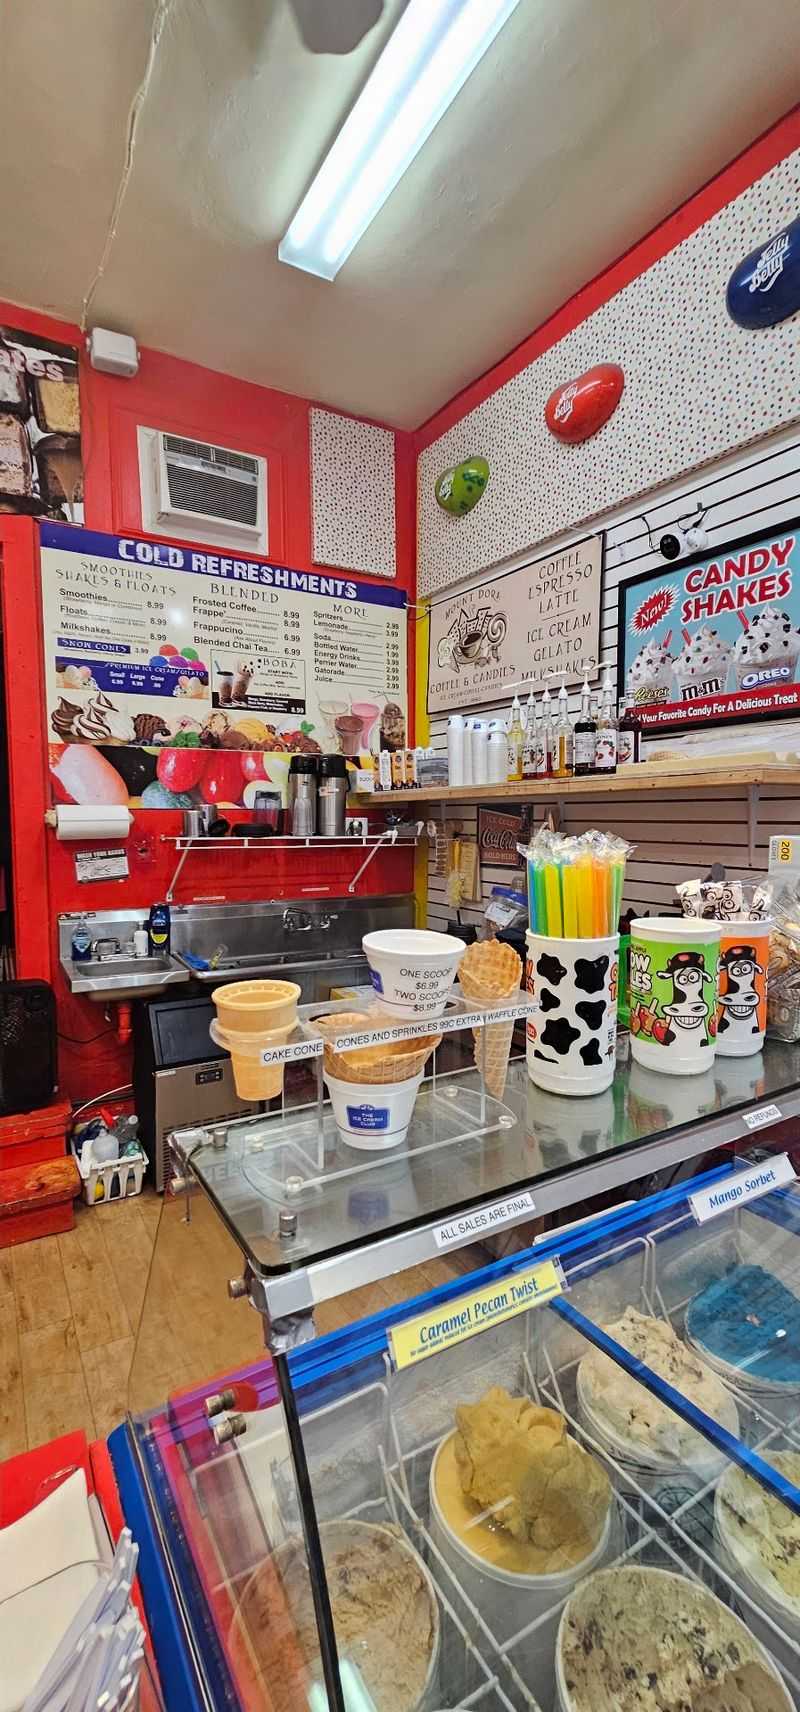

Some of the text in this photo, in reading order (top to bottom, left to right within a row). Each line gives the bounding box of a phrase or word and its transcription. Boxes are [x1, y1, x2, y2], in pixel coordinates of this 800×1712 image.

[80, 561, 153, 580] SMOOTHIES
[118, 539, 358, 599] COLD REFRESHMENTS
[538, 550, 581, 580] COFFEE
[685, 536, 796, 593] CANDY
[56, 568, 109, 588] SHAKES
[126, 581, 177, 596] FLOATS
[528, 563, 593, 600] ESPRESSO
[59, 588, 107, 602] Smoothies
[210, 582, 279, 604] BLENDED
[539, 590, 579, 614] LATTE
[681, 569, 792, 625] SHAKES
[60, 604, 88, 616] Floats
[192, 595, 300, 619] Frosted Coffee 8.99
[313, 610, 343, 621] Spritzers
[333, 604, 369, 619] MORE
[60, 621, 111, 635] Milkshakes
[193, 621, 243, 635] Frappucino
[313, 619, 348, 630] Lemonade
[527, 612, 592, 644] ICE CREAM
[62, 638, 91, 649] SNOW
[95, 642, 127, 652] CONES
[194, 636, 231, 648] Blended
[233, 640, 252, 651] Chai
[254, 643, 268, 652] Tea
[313, 633, 331, 641] Soda
[314, 641, 338, 651] Bottled
[340, 644, 358, 653] Water
[314, 649, 338, 660] Energy
[340, 653, 360, 661] Drinks
[533, 637, 583, 662] GELATO
[314, 667, 345, 676] Gatorade
[339, 660, 358, 669] Water
[521, 655, 597, 682] MILKSHAKES
[429, 678, 459, 694] COFFEE
[472, 664, 516, 684] CANDIES
[742, 666, 790, 688] OREO
[641, 713, 657, 724] Your
[658, 709, 687, 721] Favorite
[687, 704, 712, 718] Candy
[712, 702, 726, 713] For
[727, 701, 734, 711] A
[735, 695, 772, 711] Delicious
[773, 691, 798, 705] Treat
[780, 840, 791, 861] 200
[400, 968, 421, 978] ONE
[394, 989, 417, 1001] TWO
[336, 1034, 370, 1049] CONES
[372, 1030, 391, 1042] AND
[391, 1022, 438, 1040] SPRINKLES
[455, 1015, 482, 1027] EXTRA
[487, 1011, 513, 1022] WAFFLE
[515, 1005, 538, 1017] CONE
[263, 1043, 324, 1063] CAKE CONE
[708, 1169, 777, 1209] Mango Sorbet
[440, 1199, 532, 1241] ALL SALES ARE FINAL
[419, 1308, 471, 1344] Caramel
[473, 1292, 508, 1318] Pecan
[509, 1278, 539, 1302] Twist
